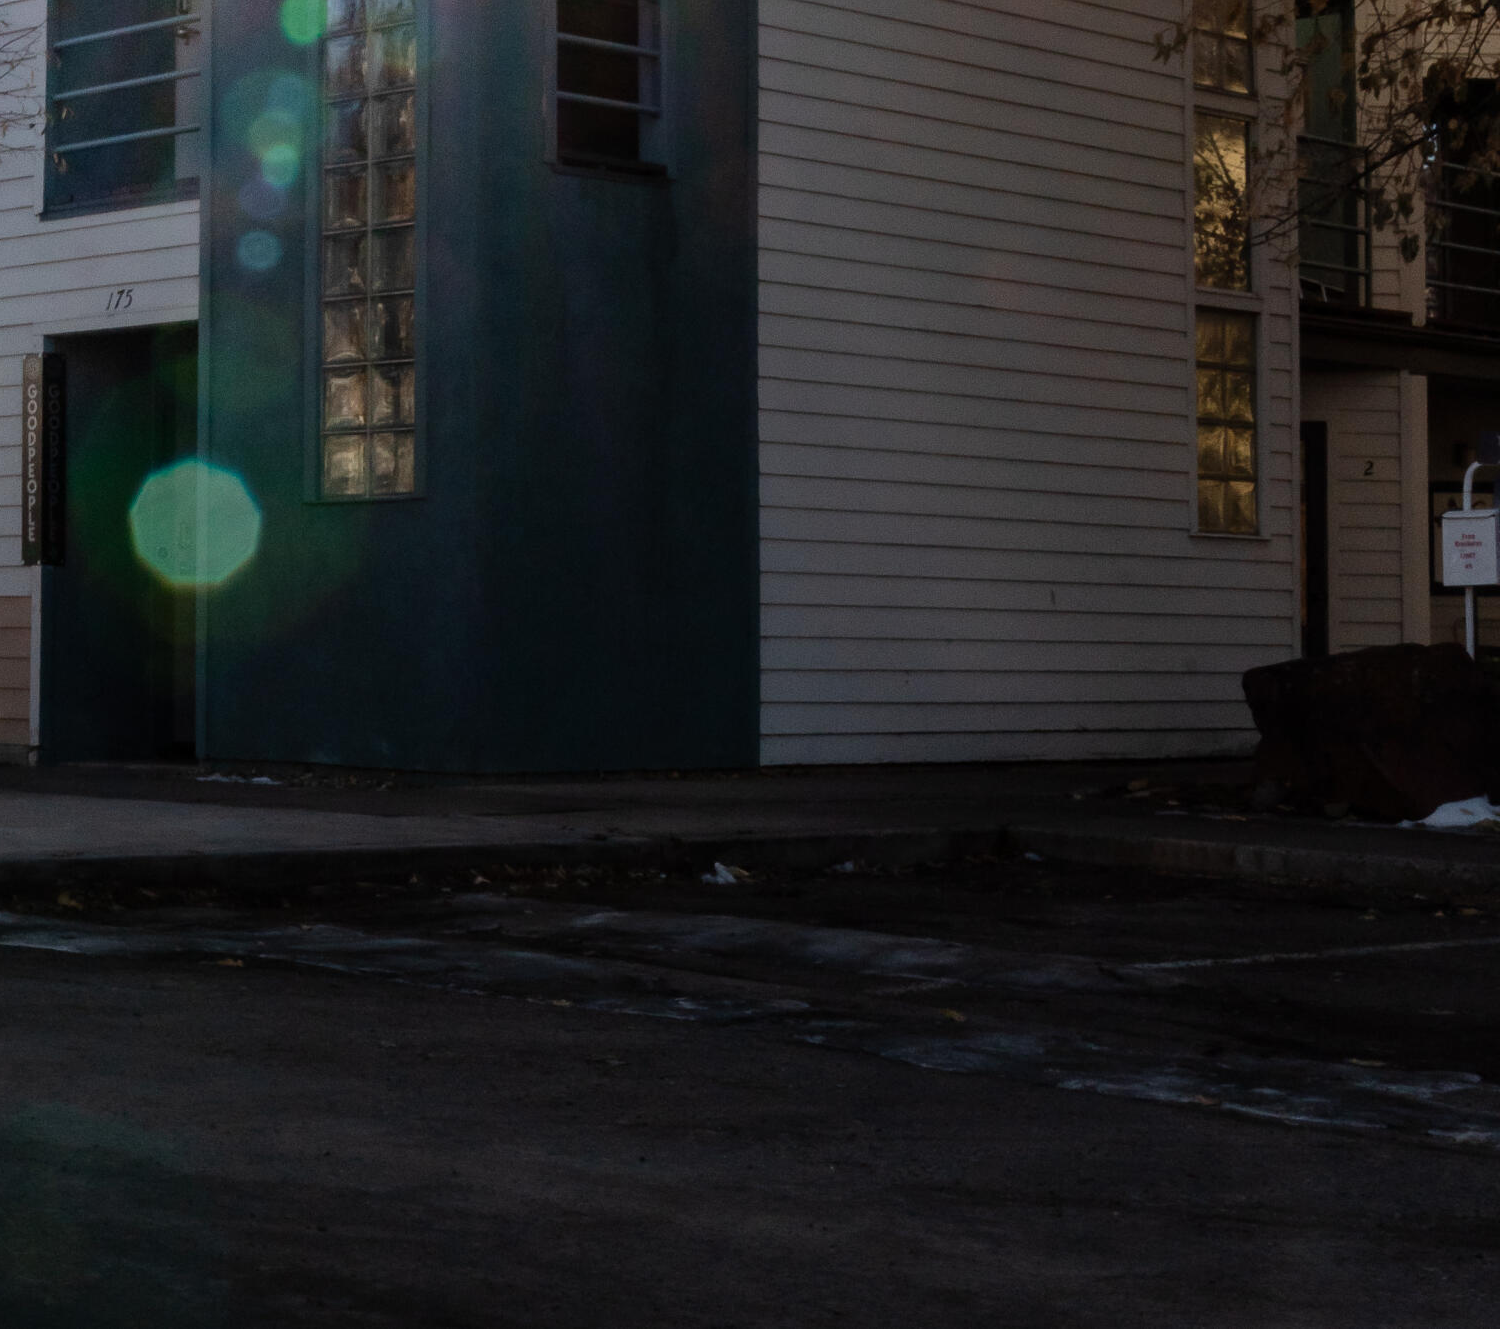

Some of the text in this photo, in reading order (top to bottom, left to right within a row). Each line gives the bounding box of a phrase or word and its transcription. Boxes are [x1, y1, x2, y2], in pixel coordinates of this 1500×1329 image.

[106, 288, 134, 311] 175
[27, 383, 38, 542] GOODPEOPLE
[1363, 460, 1374, 476] 2
